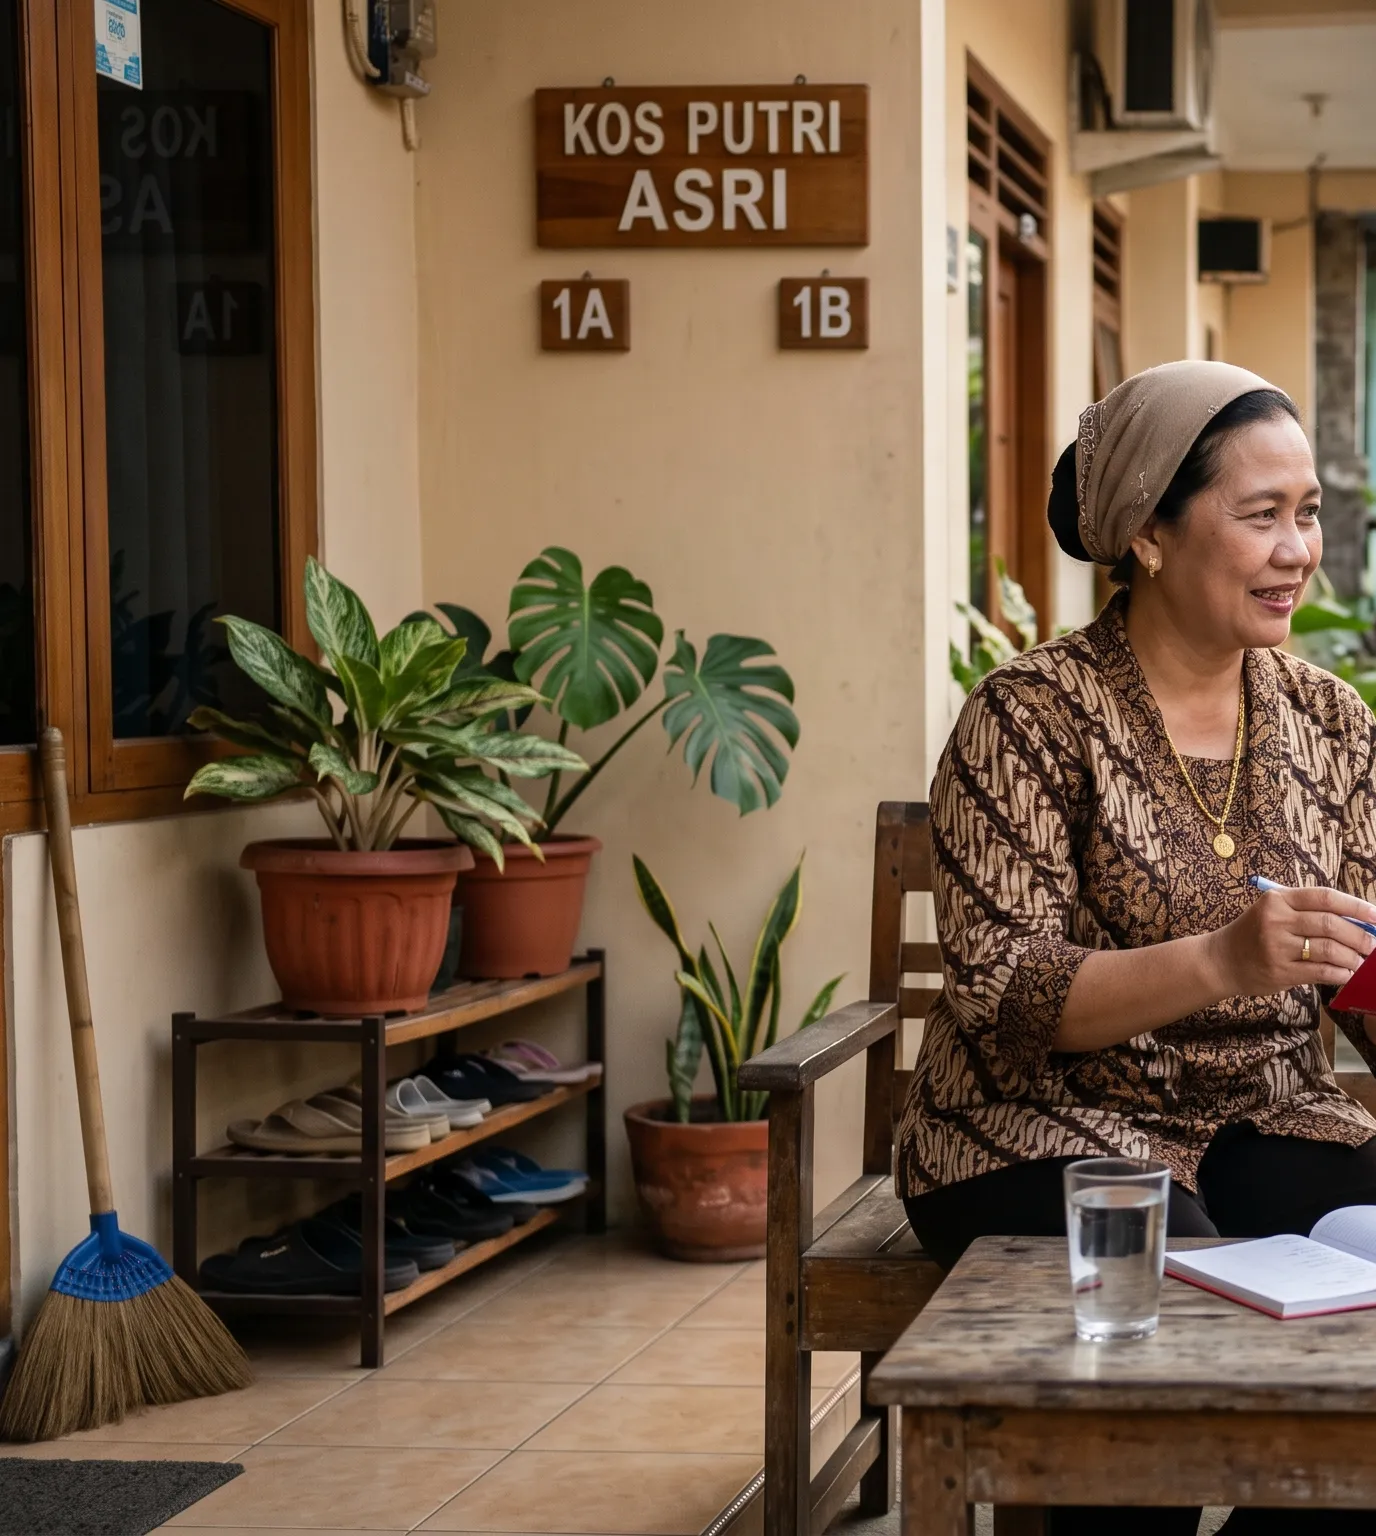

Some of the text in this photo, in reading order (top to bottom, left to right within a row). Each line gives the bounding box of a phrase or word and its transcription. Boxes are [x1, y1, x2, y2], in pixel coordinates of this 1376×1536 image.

[563, 100, 841, 155] KOS PUTRI
[618, 168, 787, 231] ASRI
[552, 288, 614, 339] 1A
[792, 286, 852, 338] 1B
